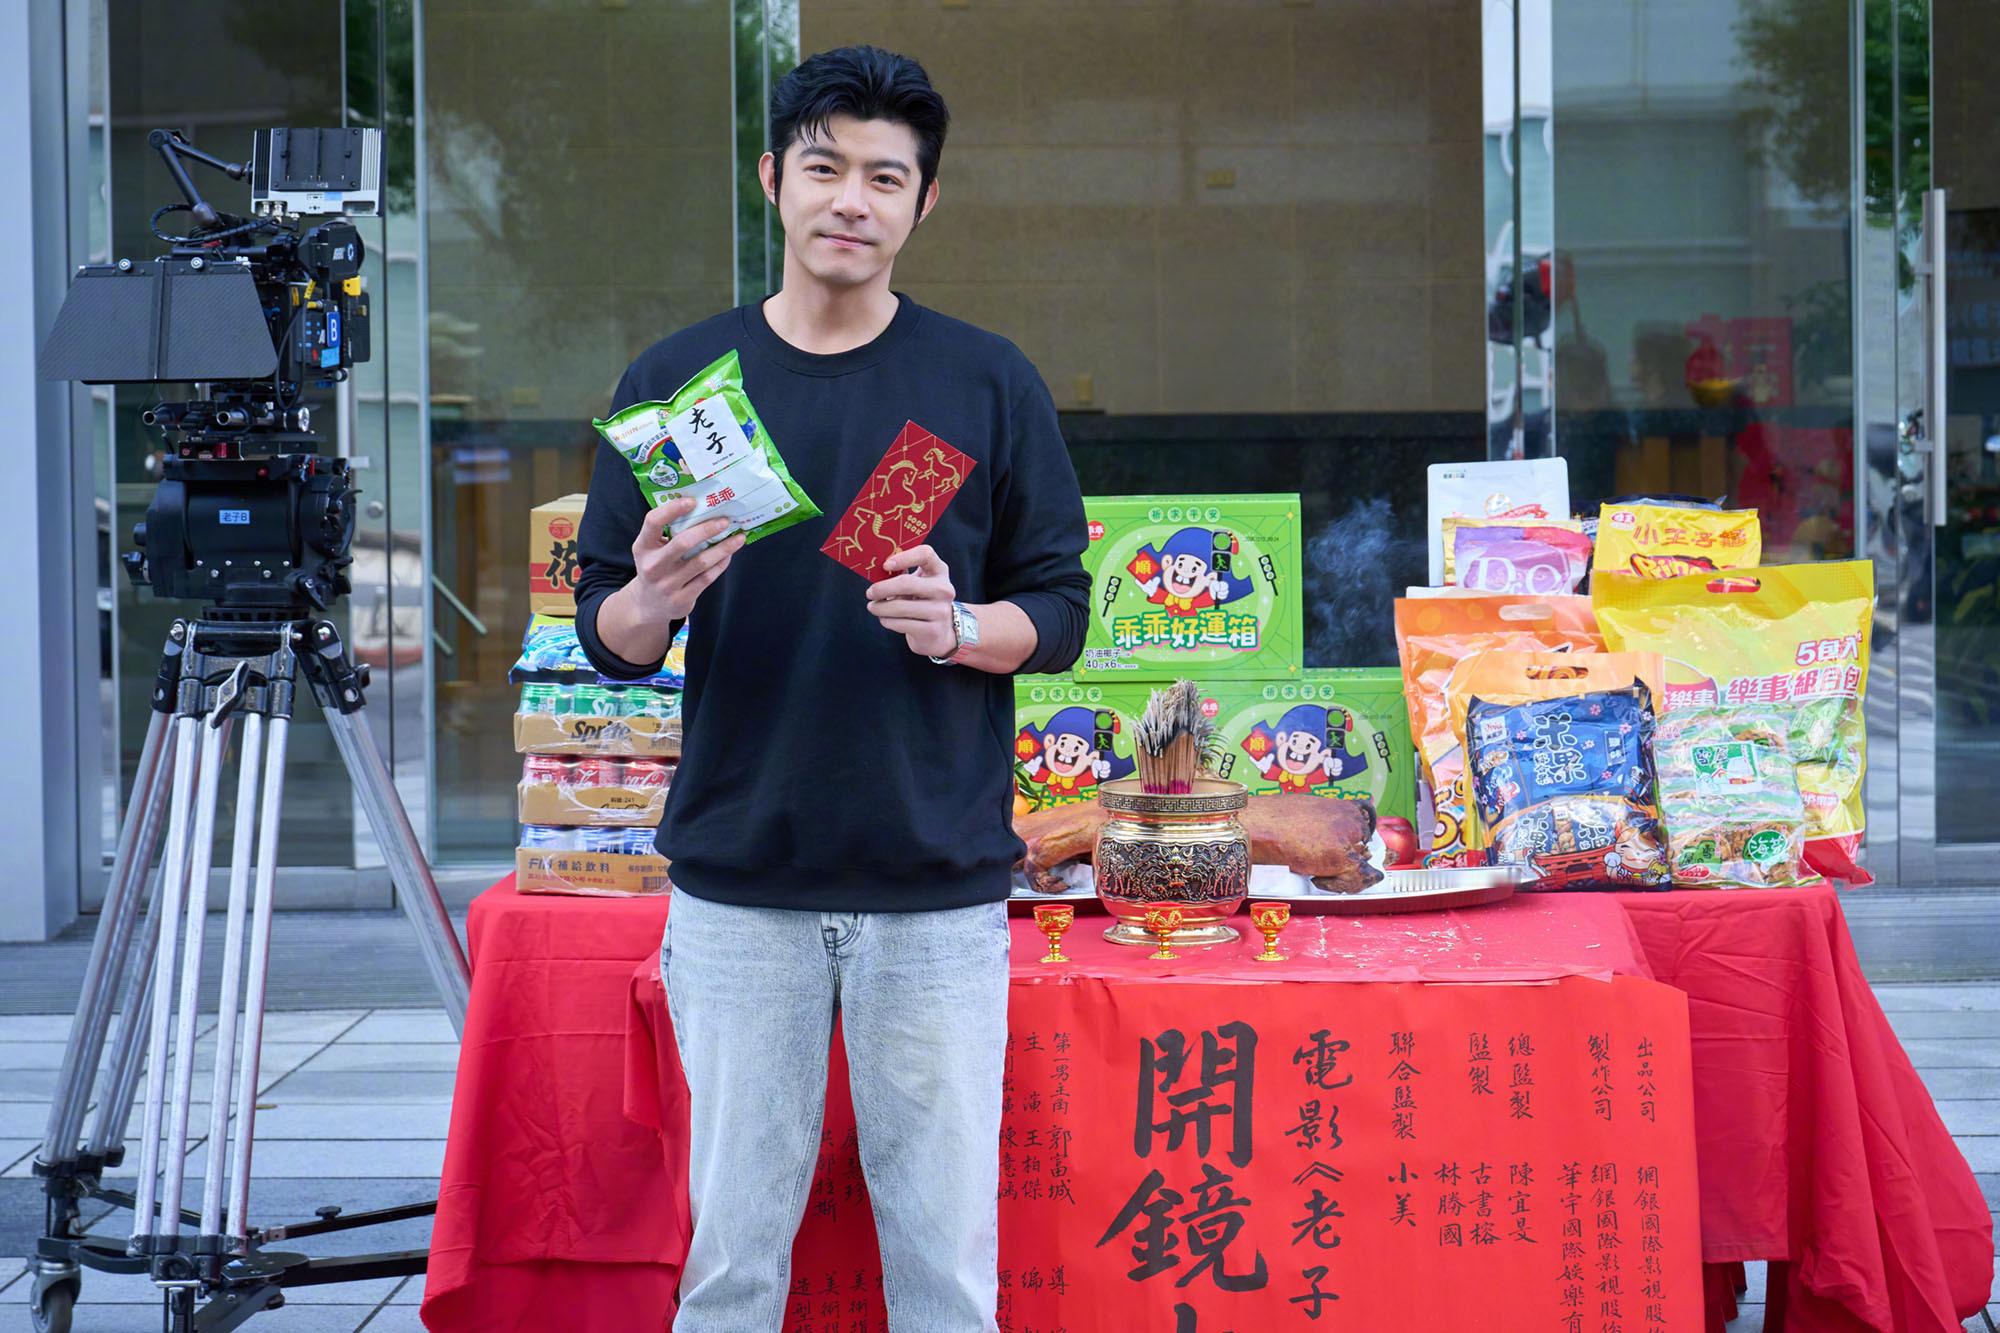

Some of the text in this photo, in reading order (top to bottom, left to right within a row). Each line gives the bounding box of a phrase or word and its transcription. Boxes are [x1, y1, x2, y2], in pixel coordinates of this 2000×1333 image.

[688, 407, 727, 455] 老子
[221, 511, 248, 521] 老子B
[706, 486, 737, 507] 乖乖
[907, 514, 928, 530] GOOD
[1151, 508, 1218, 521] 祈求平安
[1135, 560, 1152, 575] 順
[1113, 609, 1260, 650] 乖乖好運箱
[571, 720, 632, 742] Sprite
[1017, 739, 1034, 754] 順
[558, 859, 610, 873] 補給飲料
[1751, 835, 1786, 858] 海苔
[1387, 1031, 1422, 1140] 聯合監製
[1468, 1032, 1494, 1096] 監製
[1508, 1032, 1535, 1120] 總監製
[1587, 1032, 1614, 1121] 製作公司
[1637, 1036, 1656, 1123] 出品公司
[1021, 1031, 1045, 1201] 主演 王柏傑
[1044, 1124, 1076, 1205] 郭富城
[1095, 1020, 1269, 1333] 開鏡
[1388, 1162, 1419, 1227] 小美
[1434, 1162, 1466, 1247] 林勝國
[1469, 1162, 1501, 1246] 古書榕
[996, 1269, 1014, 1333] 原創故
